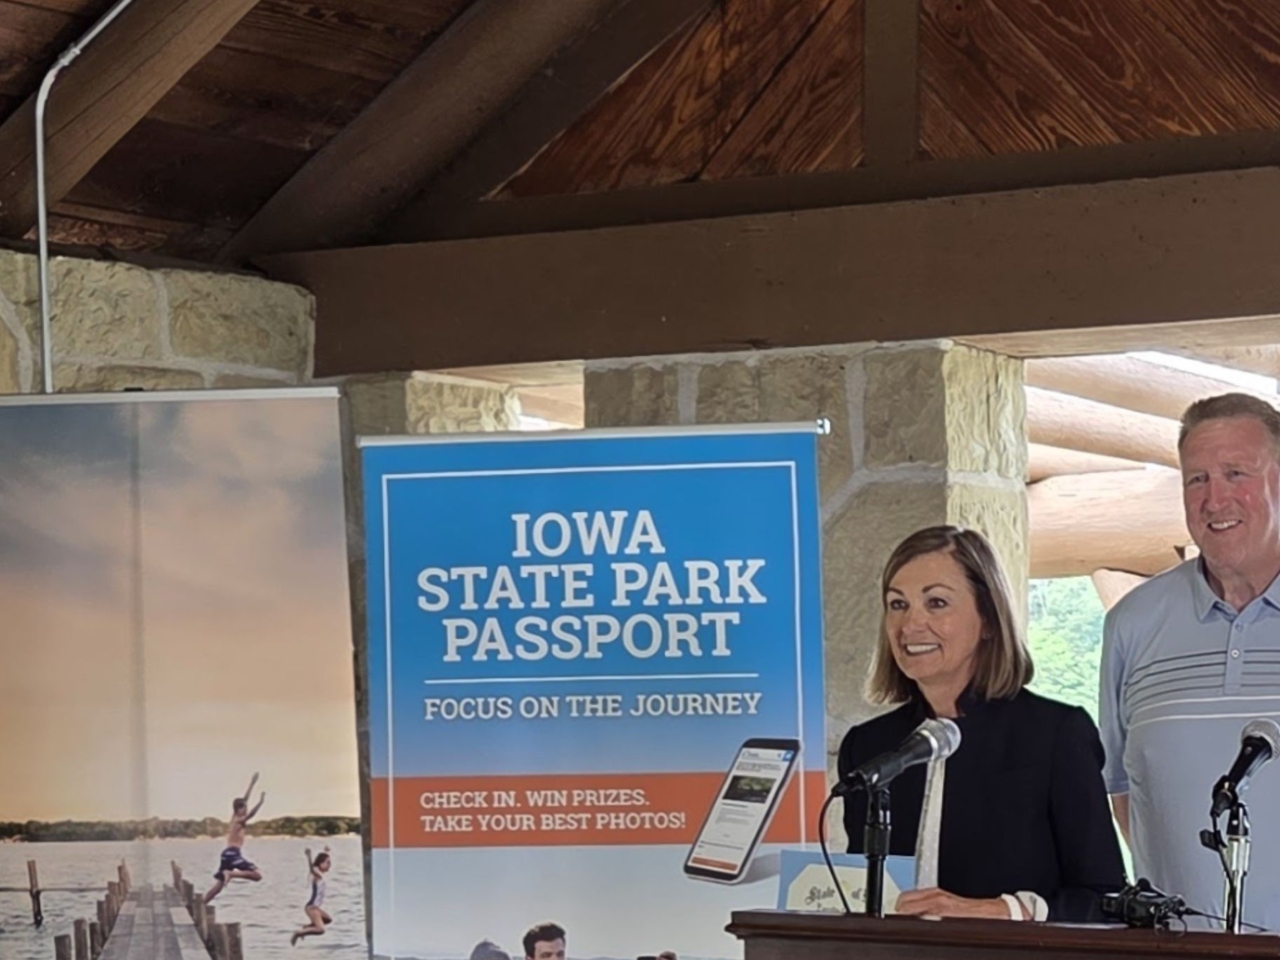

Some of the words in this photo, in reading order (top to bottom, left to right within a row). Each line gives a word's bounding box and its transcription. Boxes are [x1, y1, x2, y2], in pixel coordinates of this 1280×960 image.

[511, 510, 666, 557] IOWA
[417, 563, 594, 611] STATE
[611, 559, 767, 606] PARK
[442, 612, 740, 662] PASSPORT
[424, 697, 513, 720] FOCUS
[519, 696, 560, 718] ON
[566, 695, 622, 717] THE
[630, 692, 762, 717] JOURNEY
[420, 791, 489, 809] CHECK
[492, 791, 521, 808] IN.
[526, 790, 567, 807] WIN
[572, 789, 650, 806] PRIZES.
[420, 815, 473, 832] TAKE
[477, 814, 536, 831] YOUR
[540, 813, 591, 830] BEST
[596, 812, 686, 829] PHOTOS!
